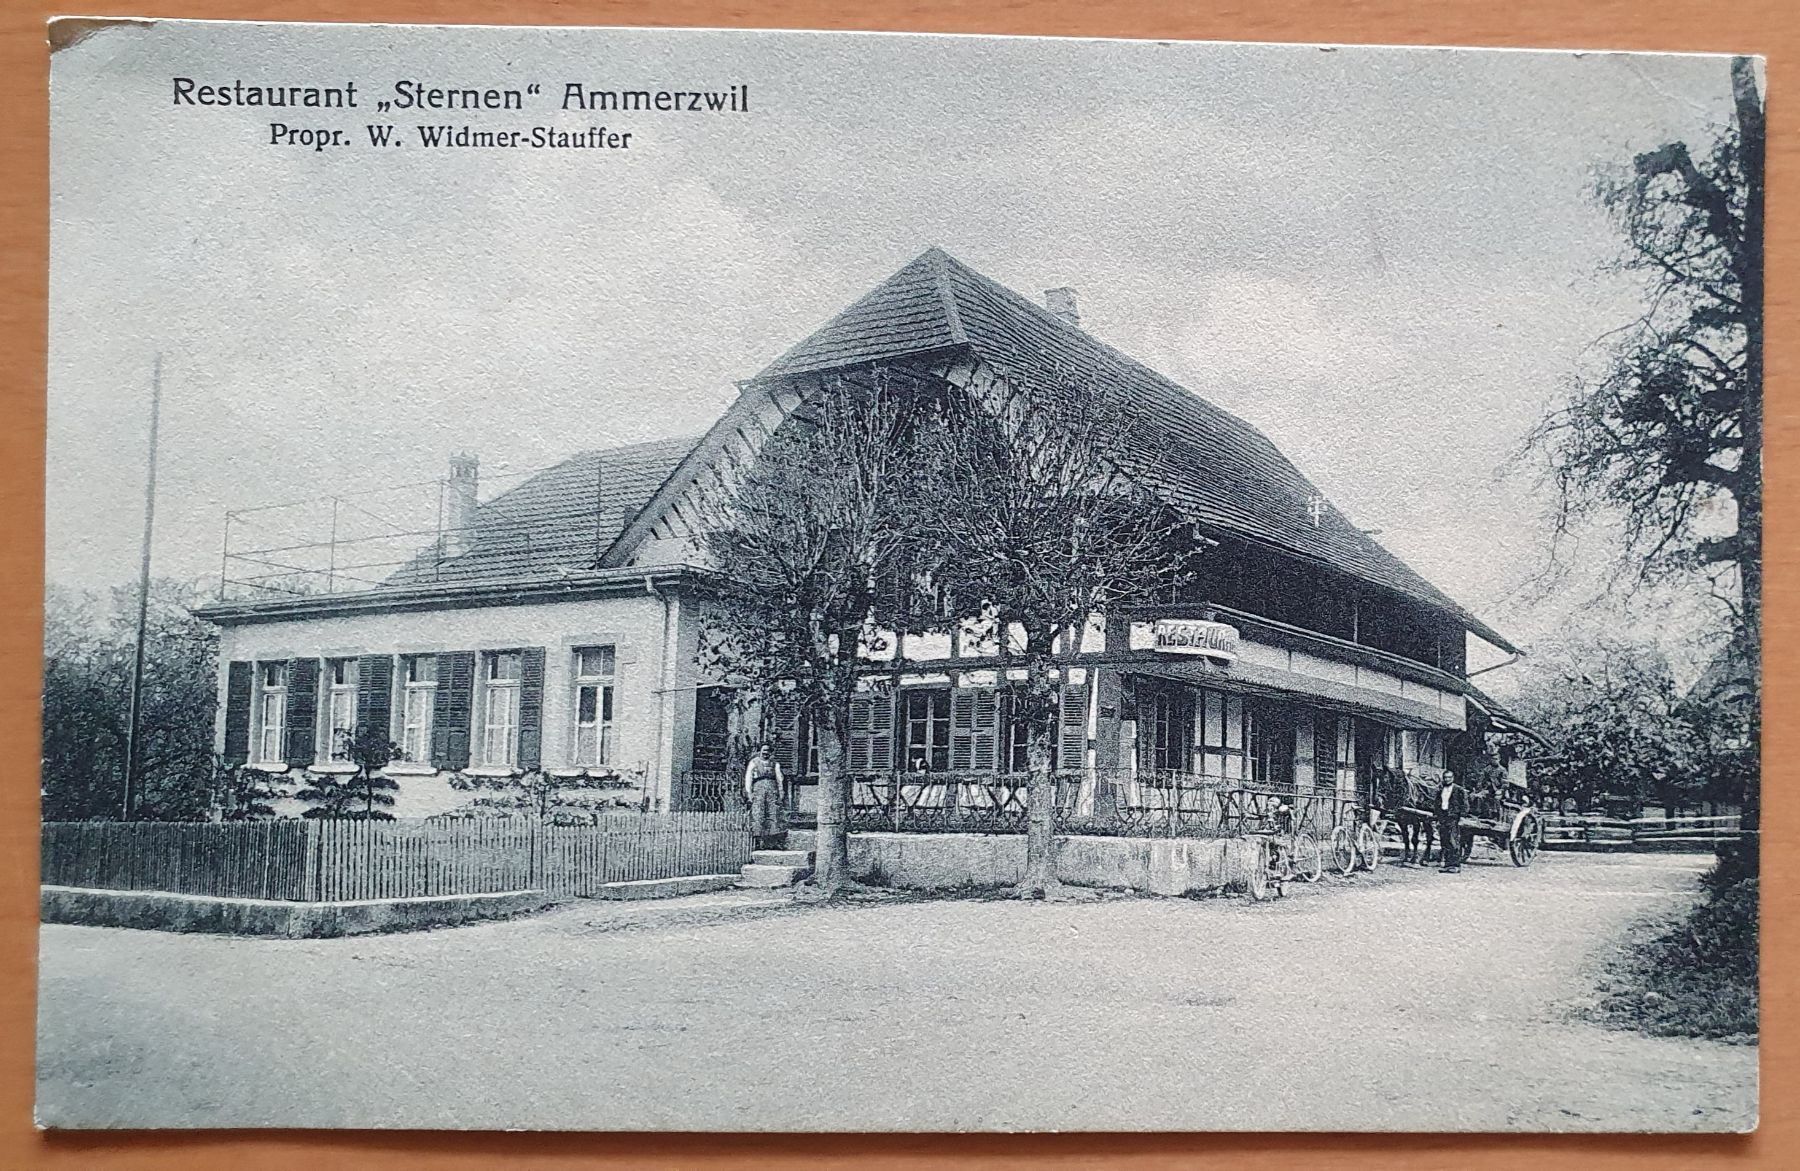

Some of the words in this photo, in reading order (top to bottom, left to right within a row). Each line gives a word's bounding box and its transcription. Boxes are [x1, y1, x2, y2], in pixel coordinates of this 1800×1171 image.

[172, 77, 358, 108] Restaurant
[377, 81, 541, 113] „Sternen“
[561, 82, 749, 113] Ammerzwil
[269, 122, 351, 153] Propr.
[366, 124, 402, 148] W.
[416, 125, 633, 149] Widmer-Stauffer
